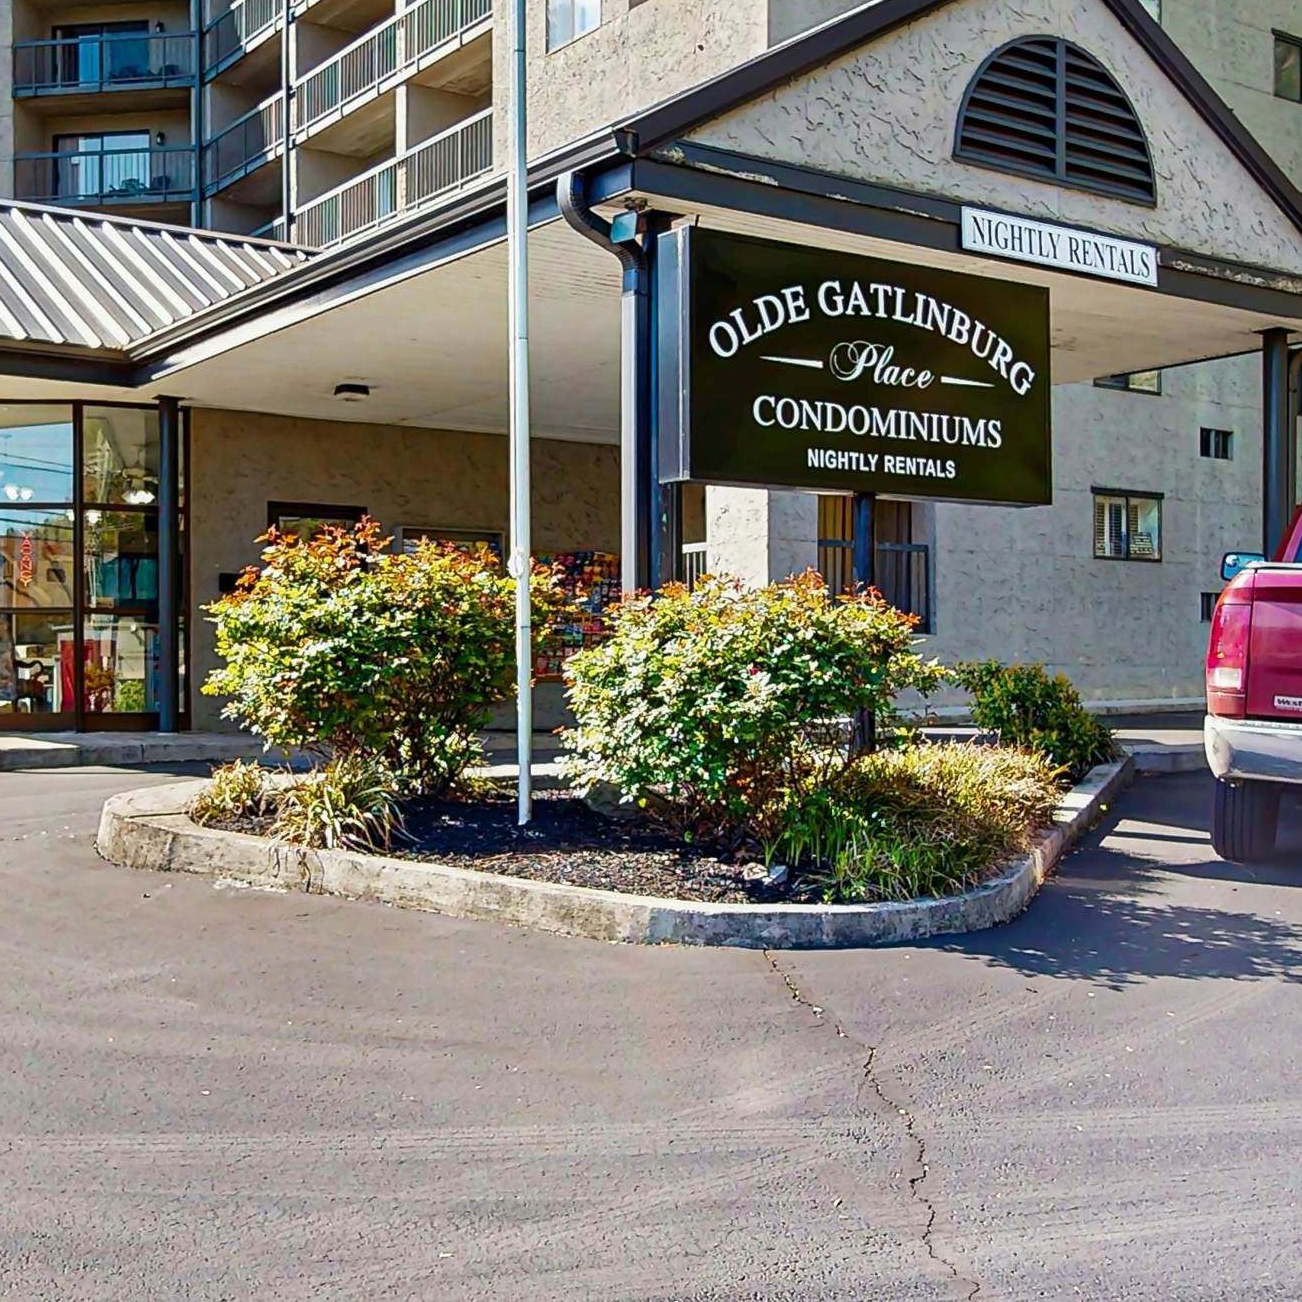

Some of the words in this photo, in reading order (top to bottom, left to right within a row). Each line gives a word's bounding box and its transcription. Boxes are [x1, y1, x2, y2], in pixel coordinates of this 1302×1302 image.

[972, 215, 1061, 260] NIGHTLY
[1068, 236, 1151, 279] RENTALS
[709, 285, 810, 358] OLDE
[817, 280, 1036, 396] GATLINBURG
[829, 340, 935, 389] Place
[753, 395, 1002, 448] CONDOMINIUMS
[807, 448, 879, 472] NIGHTLY
[884, 455, 956, 479] RENTALS
[20, 530, 33, 587] VACANCY
